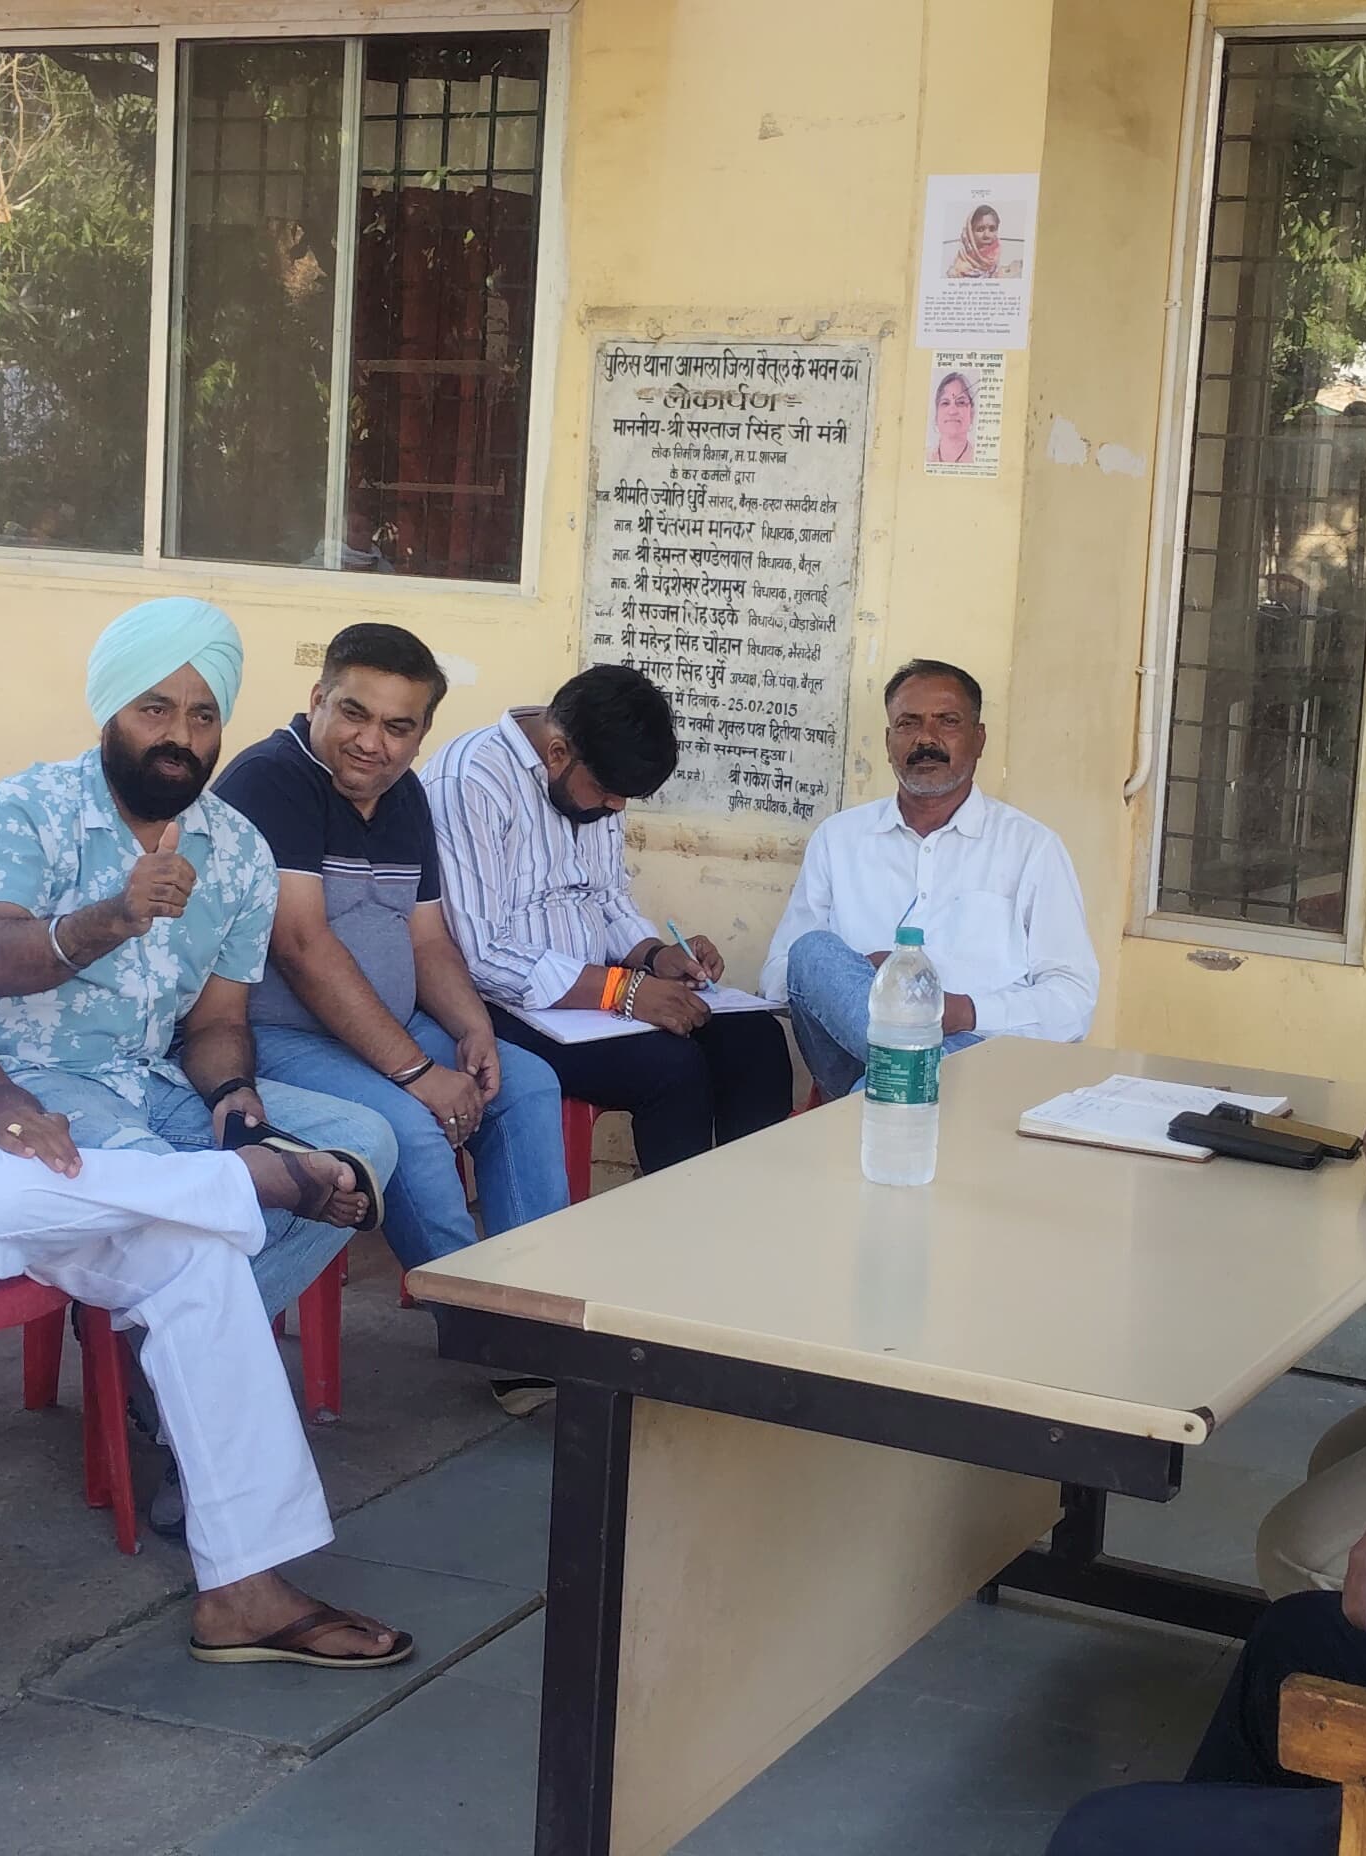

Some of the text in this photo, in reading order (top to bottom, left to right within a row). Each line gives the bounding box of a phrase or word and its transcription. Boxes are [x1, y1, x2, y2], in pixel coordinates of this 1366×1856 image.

[604, 347, 642, 382] पुलिस
[644, 354, 675, 377] थाना
[675, 355, 723, 380] आमला
[722, 348, 756, 381] जिला
[807, 358, 840, 382] भवन
[663, 382, 777, 412] लोकार्पण
[687, 421, 742, 441] सरताज
[745, 415, 786, 446] सिंह
[788, 416, 813, 442] जी
[816, 418, 847, 444] मंत्री
[651, 442, 671, 459] लोक
[672, 442, 700, 461] निर्माण
[759, 451, 788, 464] शासन
[668, 464, 679, 480] के
[681, 468, 699, 481] कर
[734, 471, 756, 486] द्वारा
[613, 478, 649, 507] श्रीमति
[650, 481, 685, 508] ज्योति
[687, 482, 708, 513] धुर्वे
[637, 509, 654, 535] श्री
[707, 519, 756, 542] मानकर
[635, 537, 651, 563] श्री
[653, 538, 688, 567] हेमन्त
[689, 541, 754, 570] खण्डेलवाल
[798, 552, 822, 577] बैतूल
[634, 566, 649, 592] श्री
[652, 567, 700, 598] चंद्रशेखर
[701, 570, 747, 602] देशमुख
[794, 584, 829, 607] मुलताई
[621, 595, 637, 620] श्री
[638, 603, 680, 624] सज्जन
[621, 623, 637, 648] श्री
[638, 625, 673, 655] महेन्द्र
[674, 627, 700, 654] सिंह
[702, 629, 743, 660] चौहान
[639, 656, 674, 683] मंगल
[676, 656, 703, 683] सिंह
[705, 658, 727, 689] धुर्वे
[800, 671, 825, 695] बैतूल
[728, 697, 798, 717] 25.07.2015
[688, 712, 715, 733] नवमी
[718, 719, 745, 740] शुक्ल
[747, 722, 766, 737] पक्ष
[769, 718, 802, 744] द्वितीया
[695, 737, 711, 753] को
[714, 743, 758, 759] सम्पन्न
[728, 763, 741, 785] श्री
[742, 764, 771, 791] राकेश
[772, 767, 793, 792] जैन
[728, 790, 752, 812] पुलिस
[793, 796, 815, 821] बैतूल
